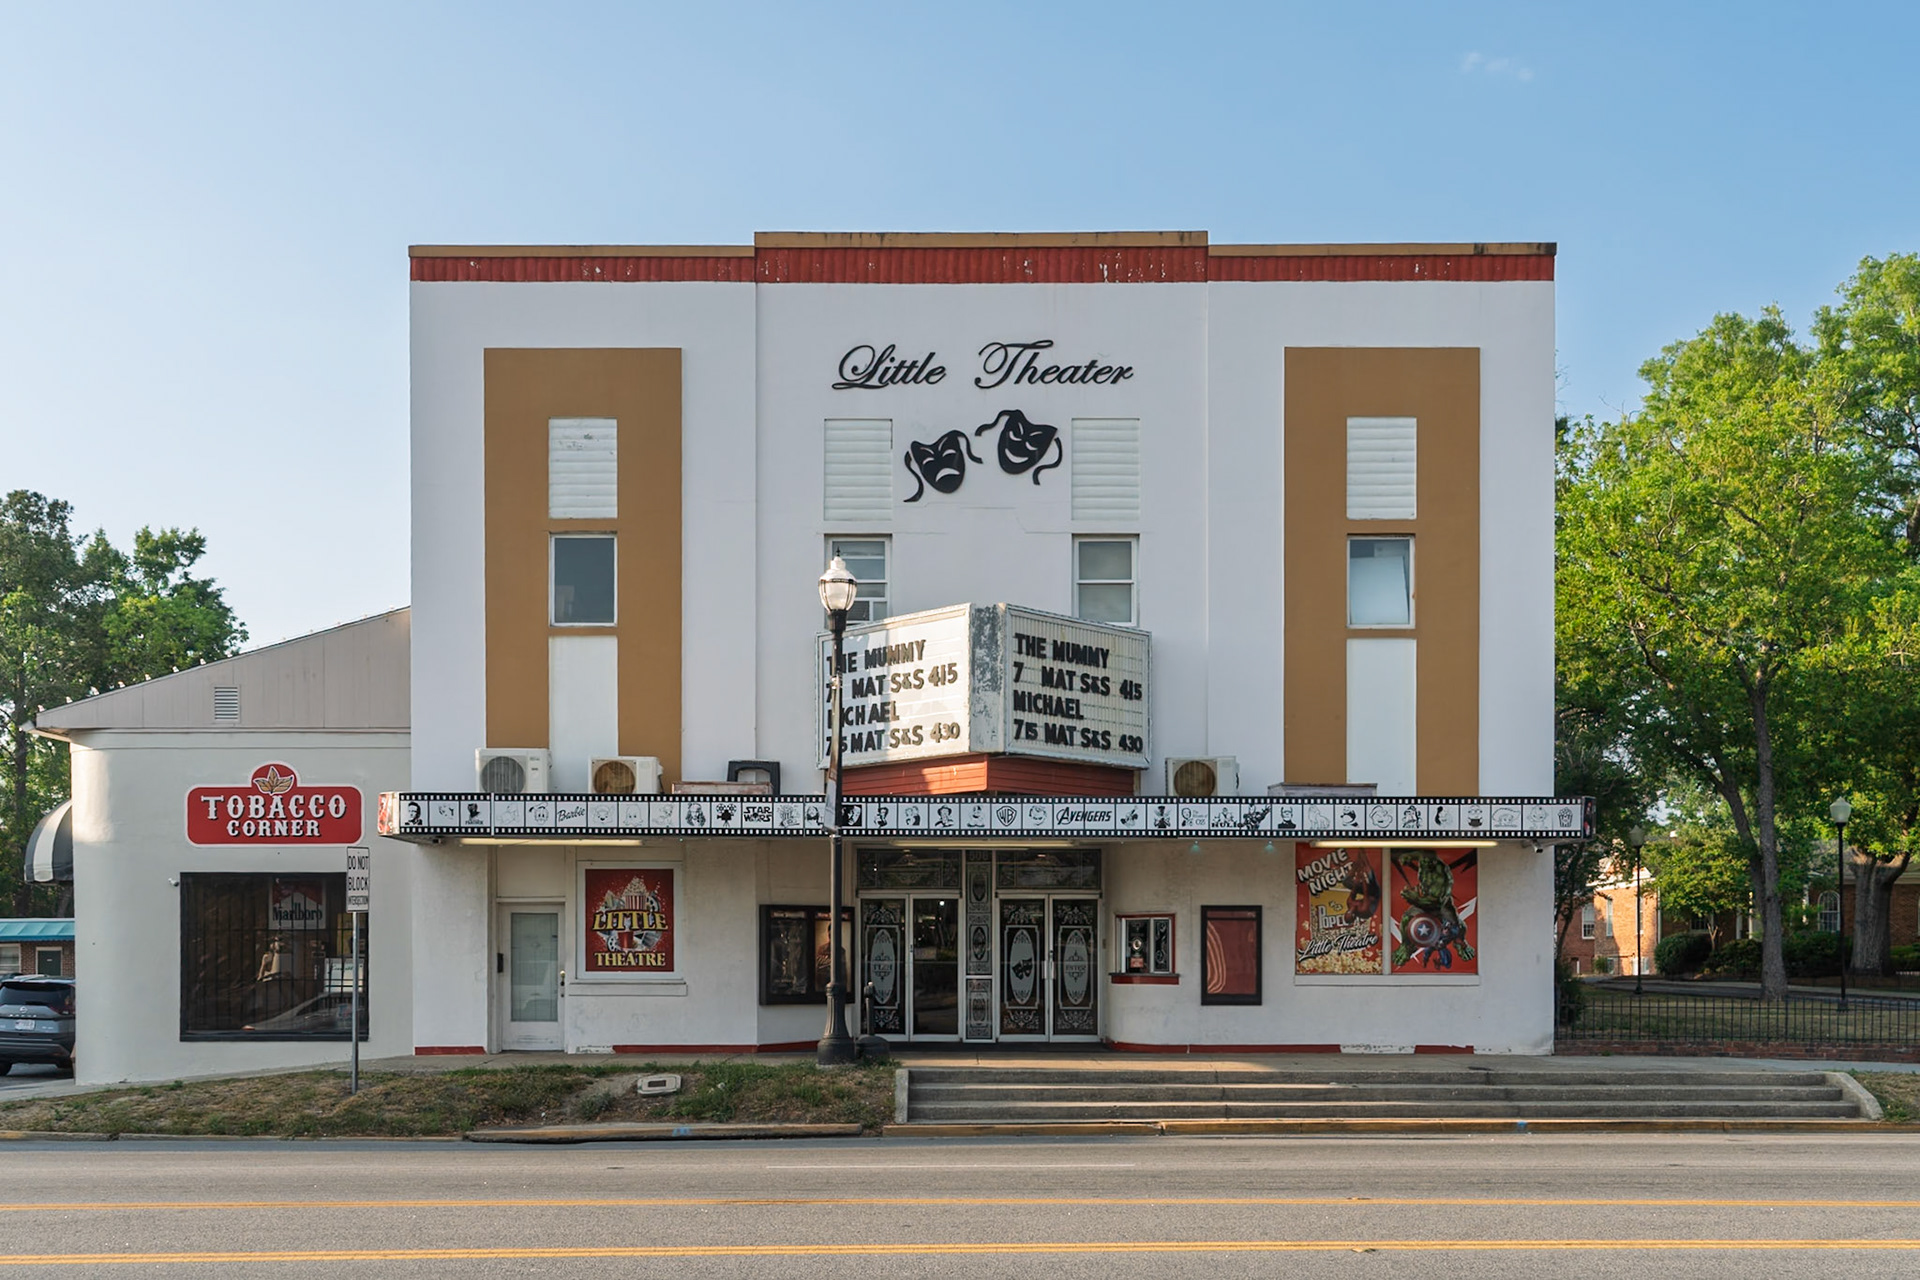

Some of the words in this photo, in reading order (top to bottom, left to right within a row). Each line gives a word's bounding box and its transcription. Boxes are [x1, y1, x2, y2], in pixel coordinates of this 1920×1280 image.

[832, 343, 947, 390] Little
[974, 339, 1135, 390] Theater
[864, 639, 927, 670] MUMMY
[1014, 632, 1047, 659] THE
[1052, 639, 1110, 669] MUMMY
[852, 674, 886, 700] MAT
[890, 668, 925, 693] S&S
[928, 662, 959, 687] 415
[1013, 661, 1025, 683] 7
[1041, 665, 1077, 691] MAT
[1080, 672, 1111, 697] S&S
[1118, 679, 1143, 701] 415
[1013, 689, 1084, 720] MICHAEL
[826, 736, 848, 757] 75
[851, 729, 886, 754] MAT
[889, 725, 924, 749] S&S
[930, 722, 961, 744] 430
[1044, 722, 1077, 747] MAT
[1080, 727, 1112, 750] S&S
[1118, 734, 1144, 753] 430
[200, 794, 347, 820] TOBACCO
[557, 806, 585, 822] Barbie
[1000, 807, 1016, 824] WB
[1056, 806, 1113, 825] AVENGERS
[226, 819, 322, 837] CORNER
[348, 855, 356, 870] DO
[357, 855, 369, 870] NOT
[1297, 848, 1349, 882] MOVIE
[348, 876, 369, 891] BLOCK
[1308, 861, 1354, 896] NIGHT
[272, 902, 323, 921] Marlboro
[592, 909, 669, 931] LITTLE
[594, 952, 666, 967] THEATRE
[1298, 936, 1331, 962] Little
[1332, 931, 1379, 955] Theatre
